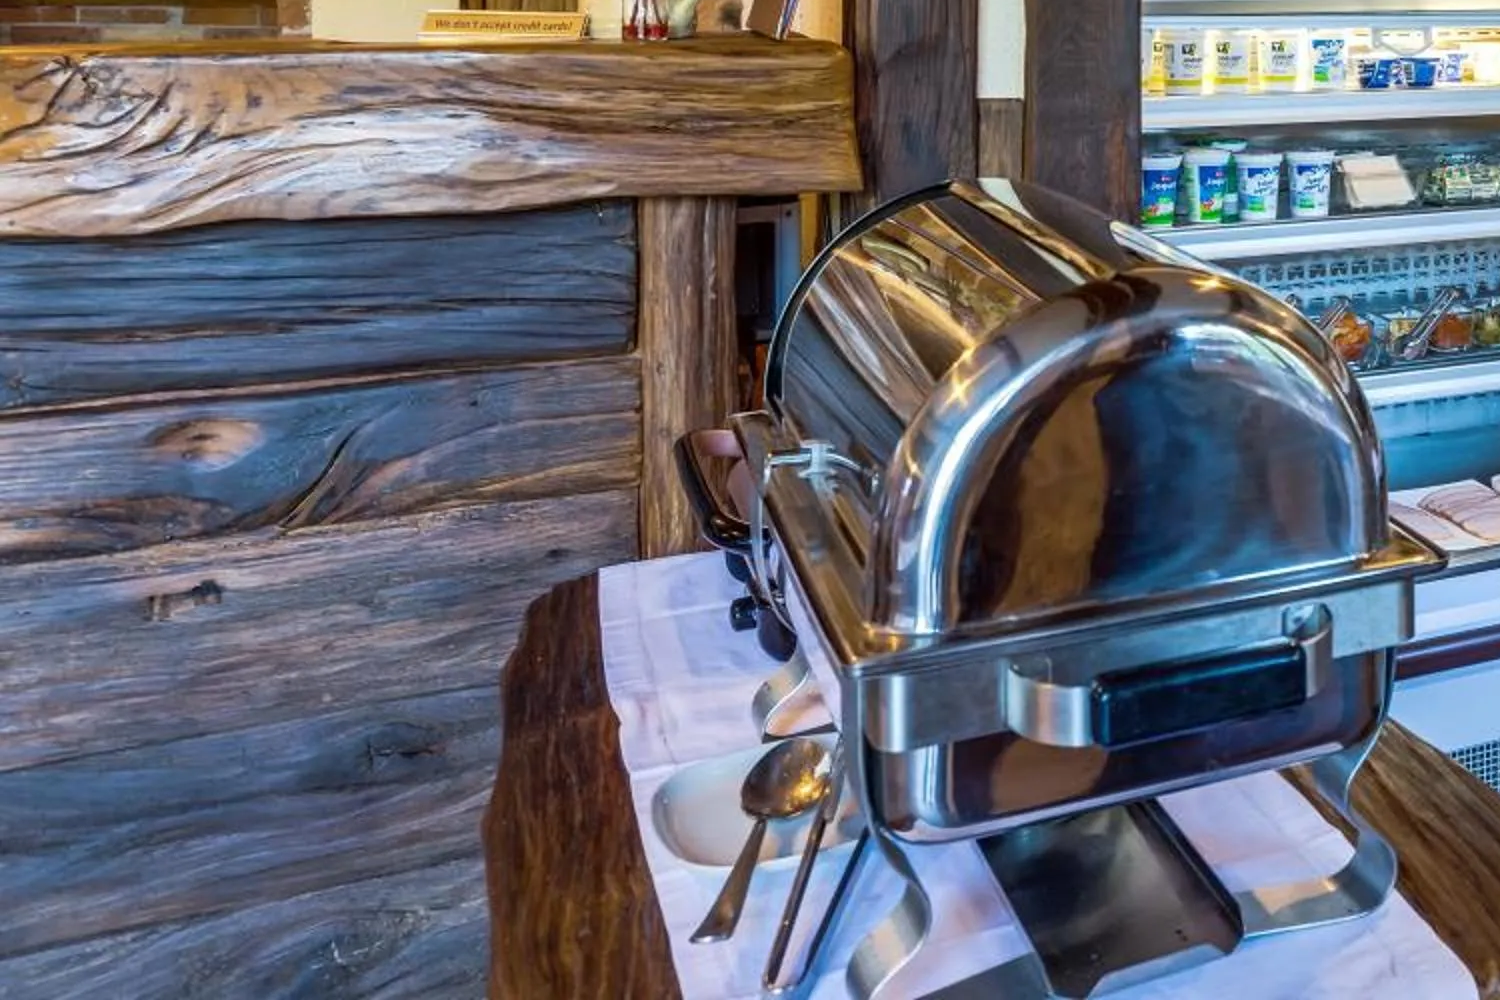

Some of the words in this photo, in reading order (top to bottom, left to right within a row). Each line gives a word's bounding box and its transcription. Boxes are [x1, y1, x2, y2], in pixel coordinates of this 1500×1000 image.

[435, 19, 450, 29] We
[452, 19, 479, 29] don't
[479, 21, 511, 32] accept
[513, 21, 541, 31] credit
[542, 21, 573, 31] cards!
